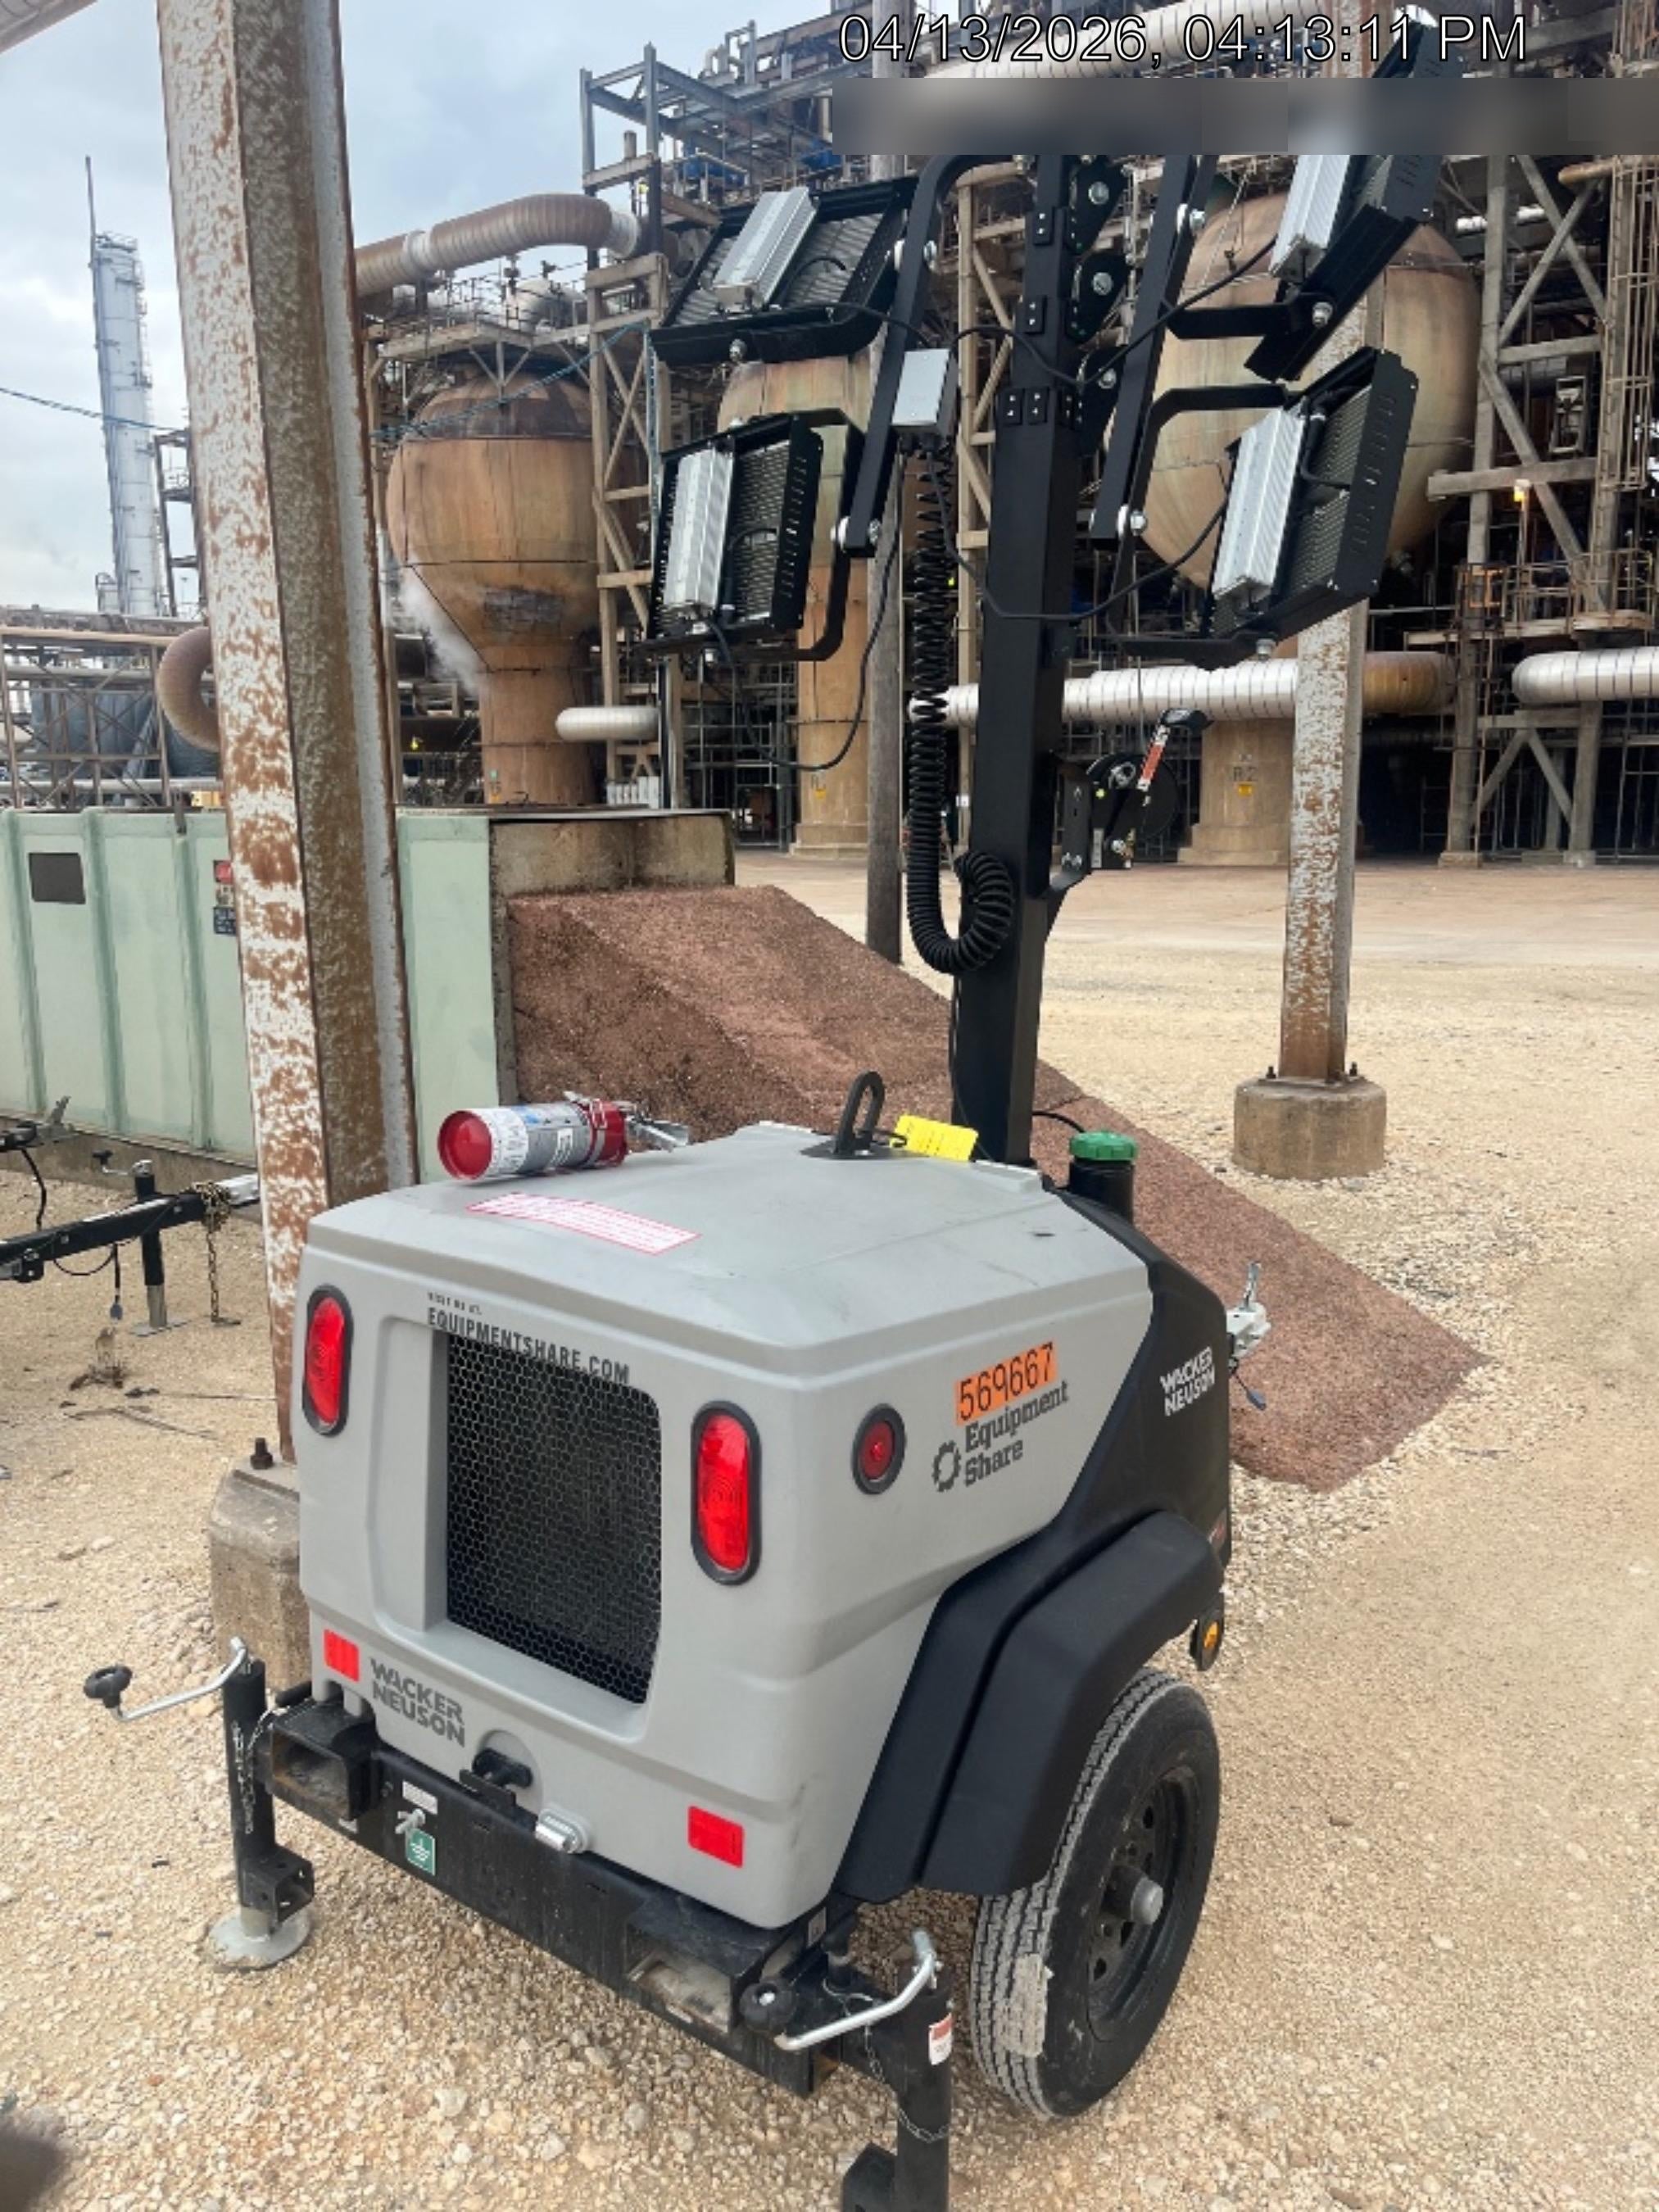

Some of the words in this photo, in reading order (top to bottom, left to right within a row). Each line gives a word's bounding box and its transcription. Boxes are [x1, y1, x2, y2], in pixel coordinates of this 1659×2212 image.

[428, 1307, 630, 1384] EQUIPMENTSHARE.COM
[1159, 1346, 1213, 1394] WACKER
[960, 1342, 1054, 1421] 569667
[1165, 1364, 1215, 1416] NEUSON
[965, 1380, 1068, 1453] Equipment
[965, 1439, 1023, 1487] Share
[370, 1657, 465, 1725] WACKER
[373, 1680, 465, 1748] NEUSON
